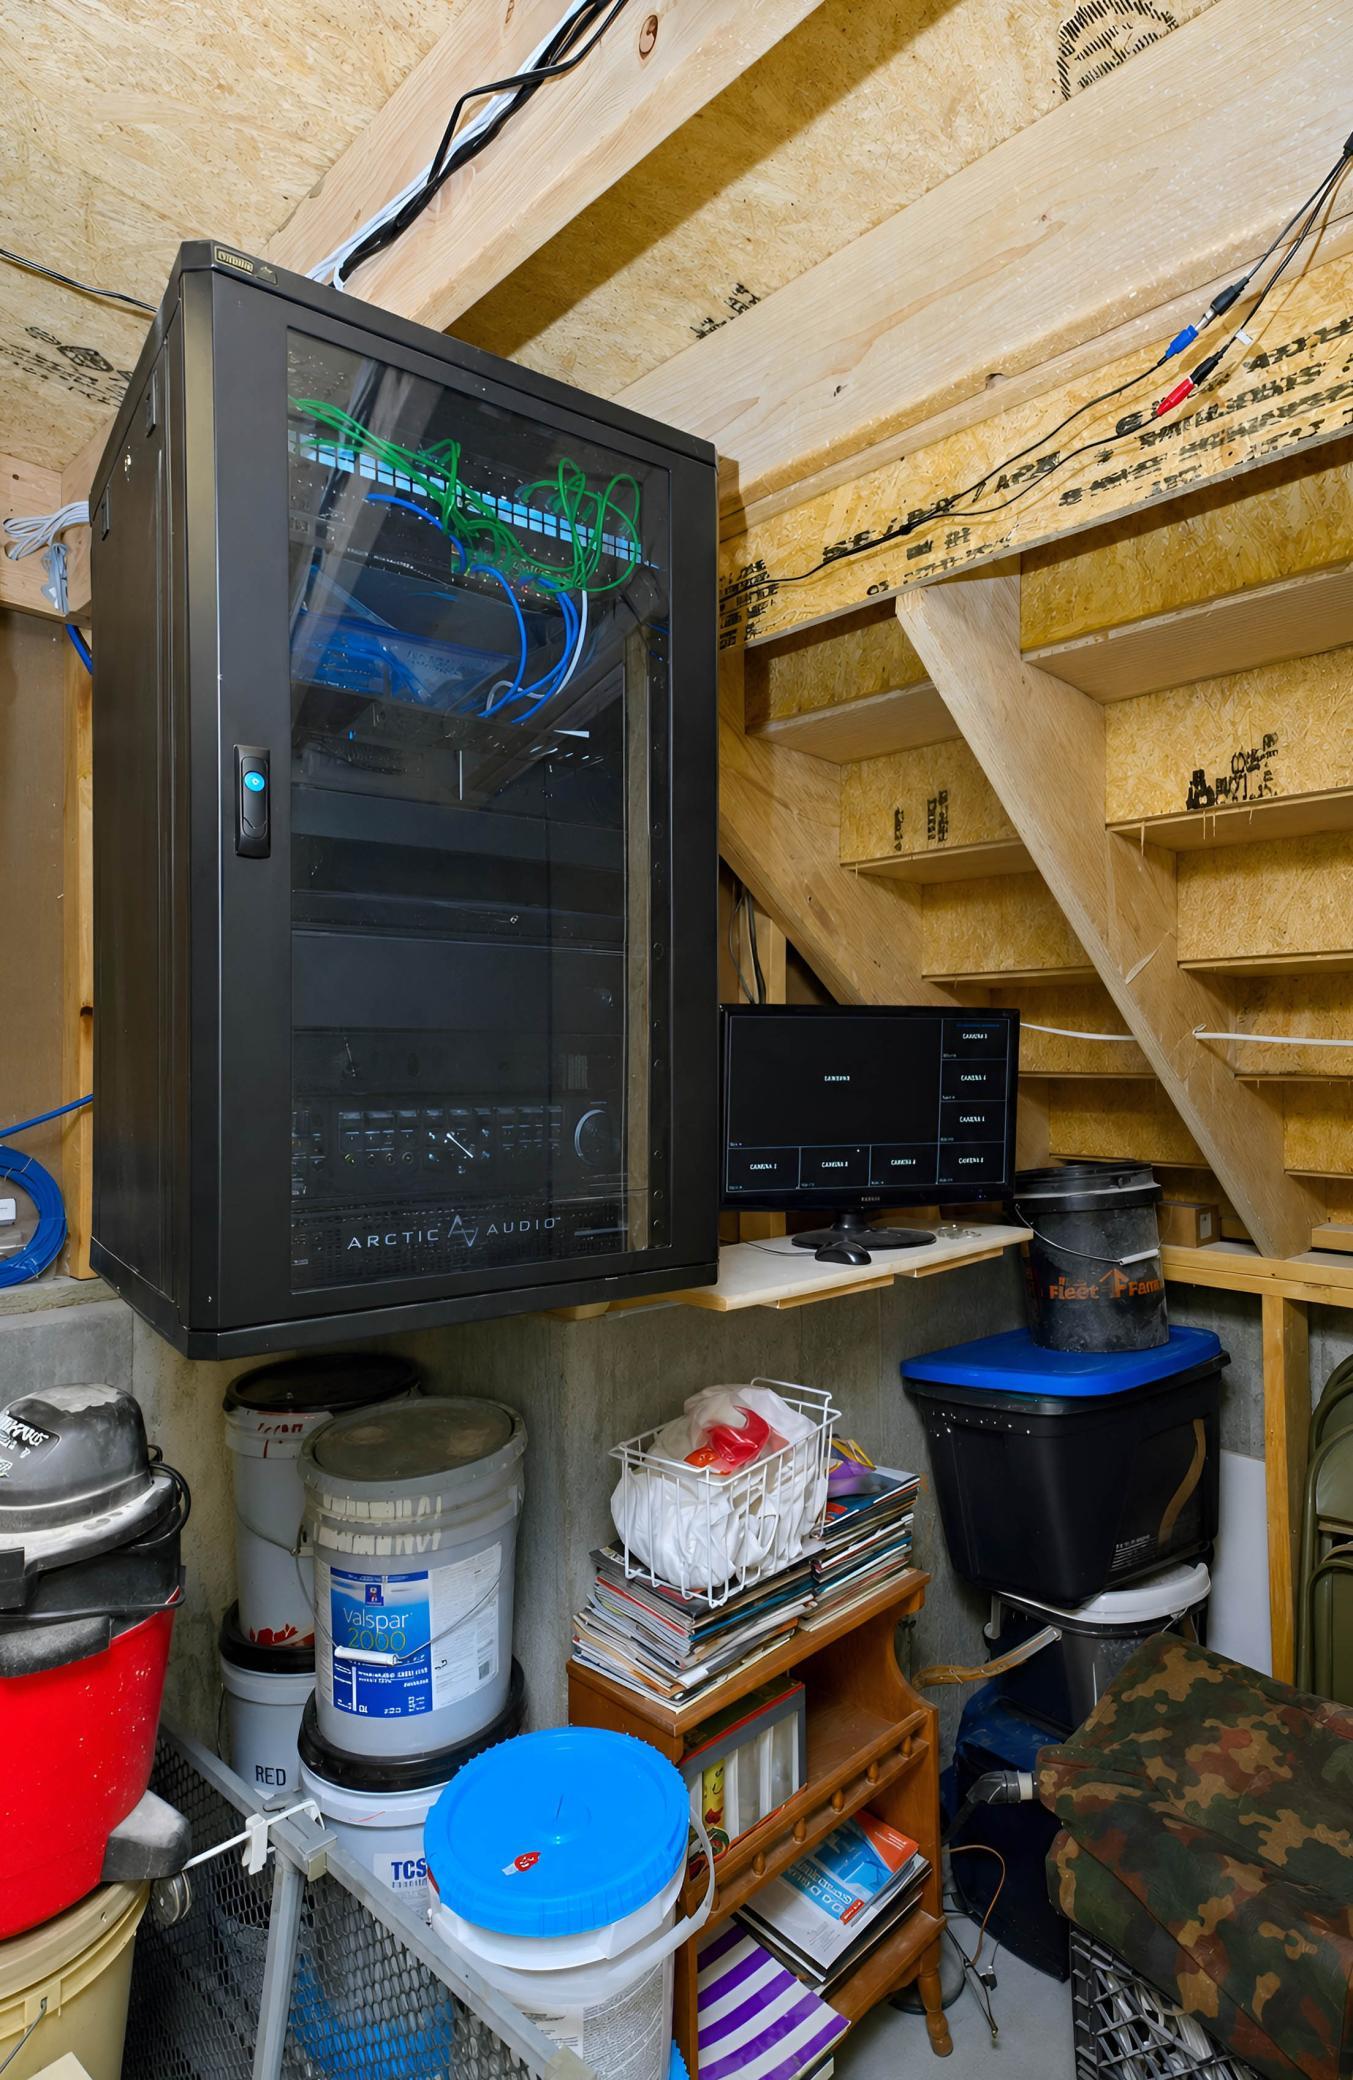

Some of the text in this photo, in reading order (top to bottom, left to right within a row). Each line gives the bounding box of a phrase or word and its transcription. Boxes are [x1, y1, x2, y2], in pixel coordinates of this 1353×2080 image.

[347, 1229, 439, 1250] ARCTIC
[343, 1607, 409, 1634] Valspar
[349, 1627, 407, 1652] 2000
[255, 1765, 287, 1786] RED
[391, 1857, 427, 1881] TCS
